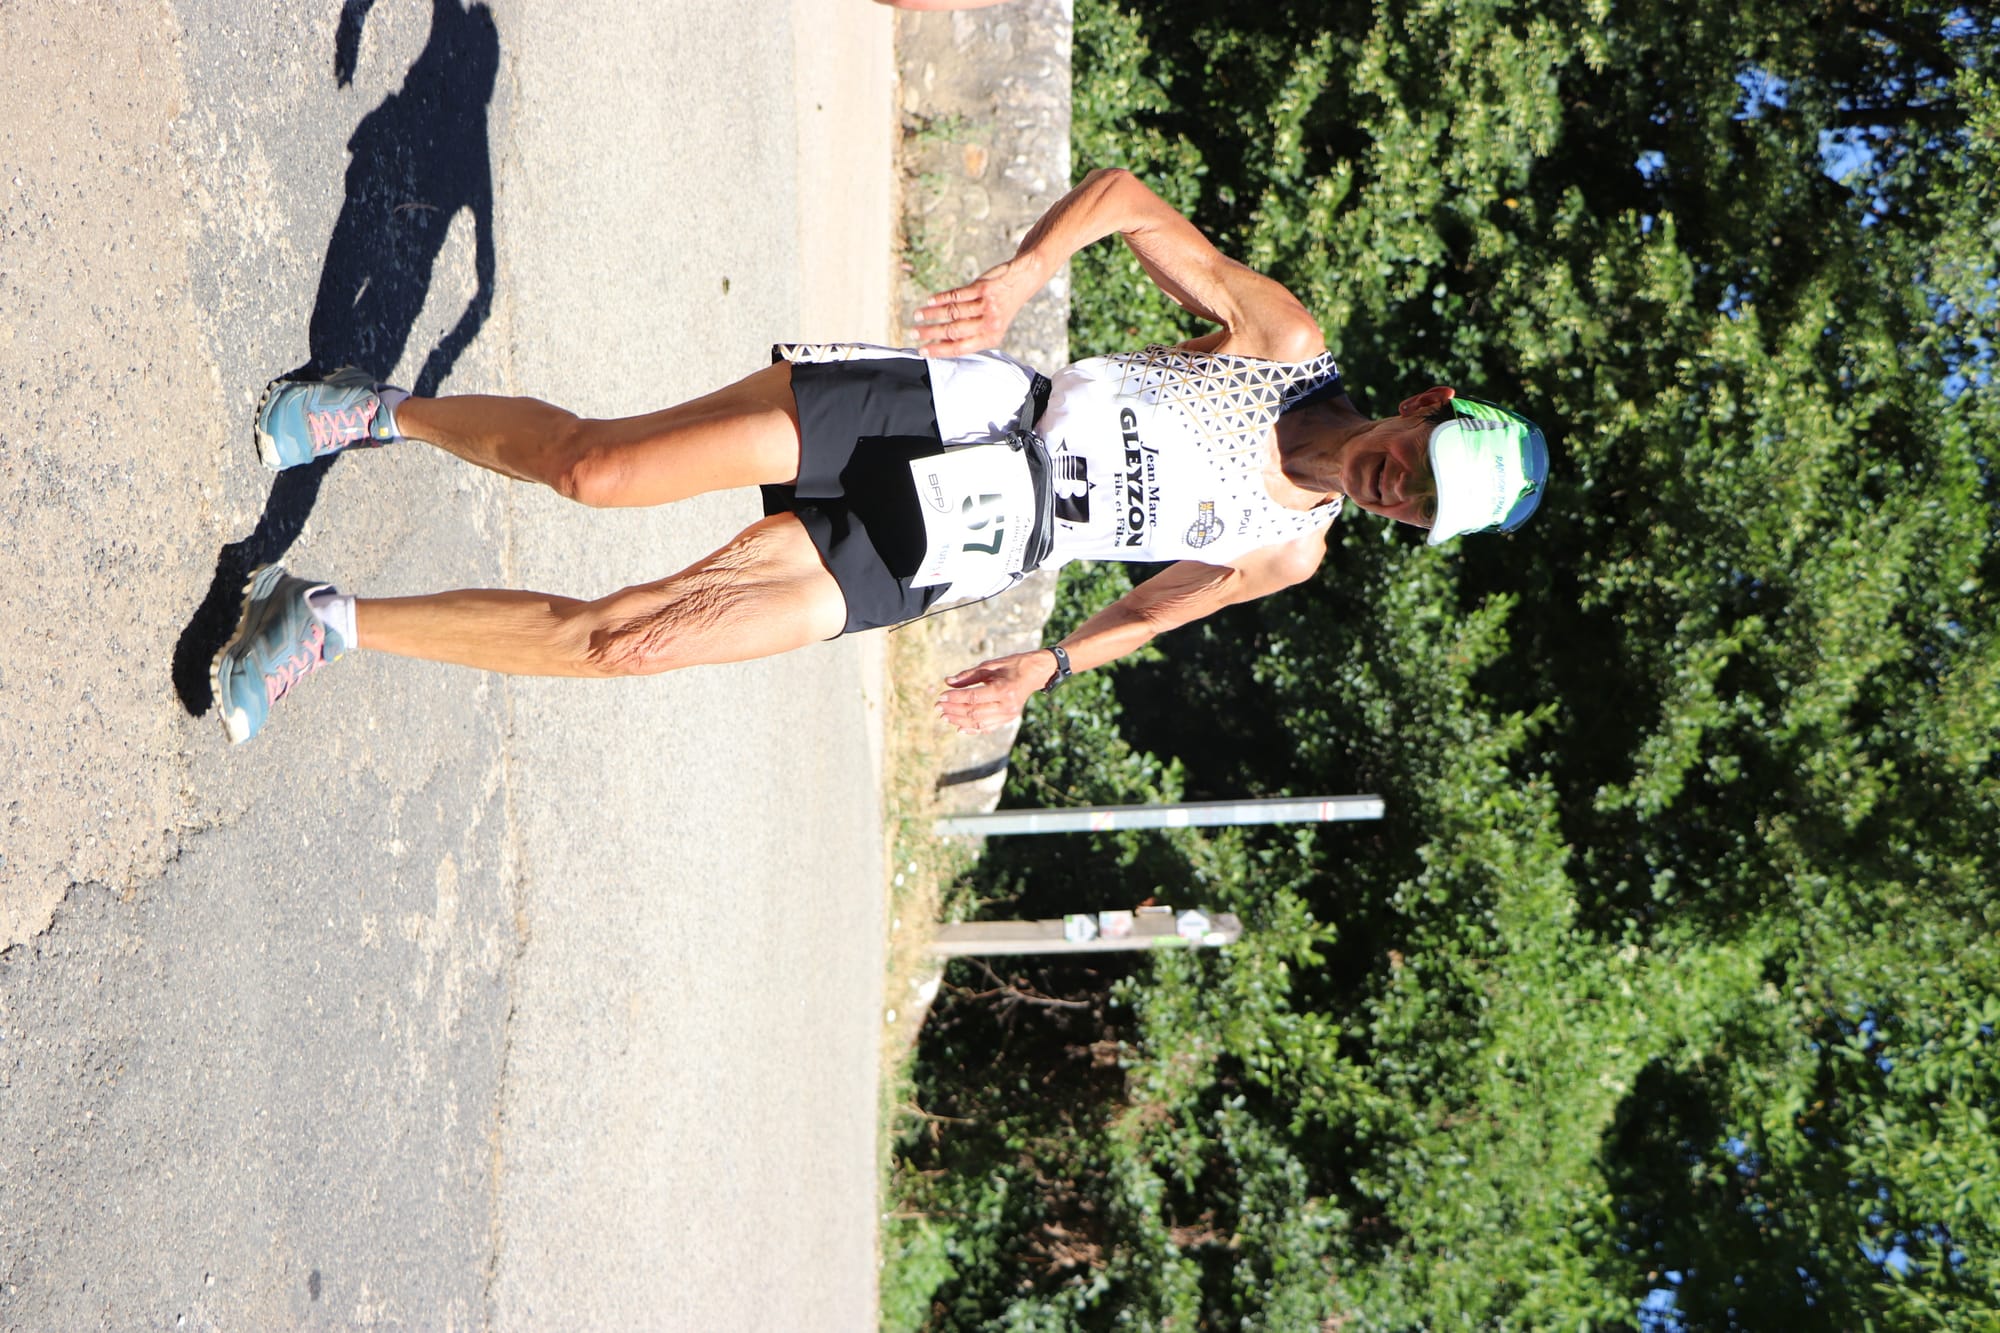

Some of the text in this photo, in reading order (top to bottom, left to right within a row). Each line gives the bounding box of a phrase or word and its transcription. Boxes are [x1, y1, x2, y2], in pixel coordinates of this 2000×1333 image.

[928, 474, 945, 508] BFP
[1114, 472, 1123, 497] Fils
[1120, 407, 1145, 547] GLEYZON
[1141, 441, 1161, 527] Jean Marc
[1116, 501, 1122, 513] et
[1238, 509, 1252, 536] POLI
[961, 493, 1005, 556] 57
